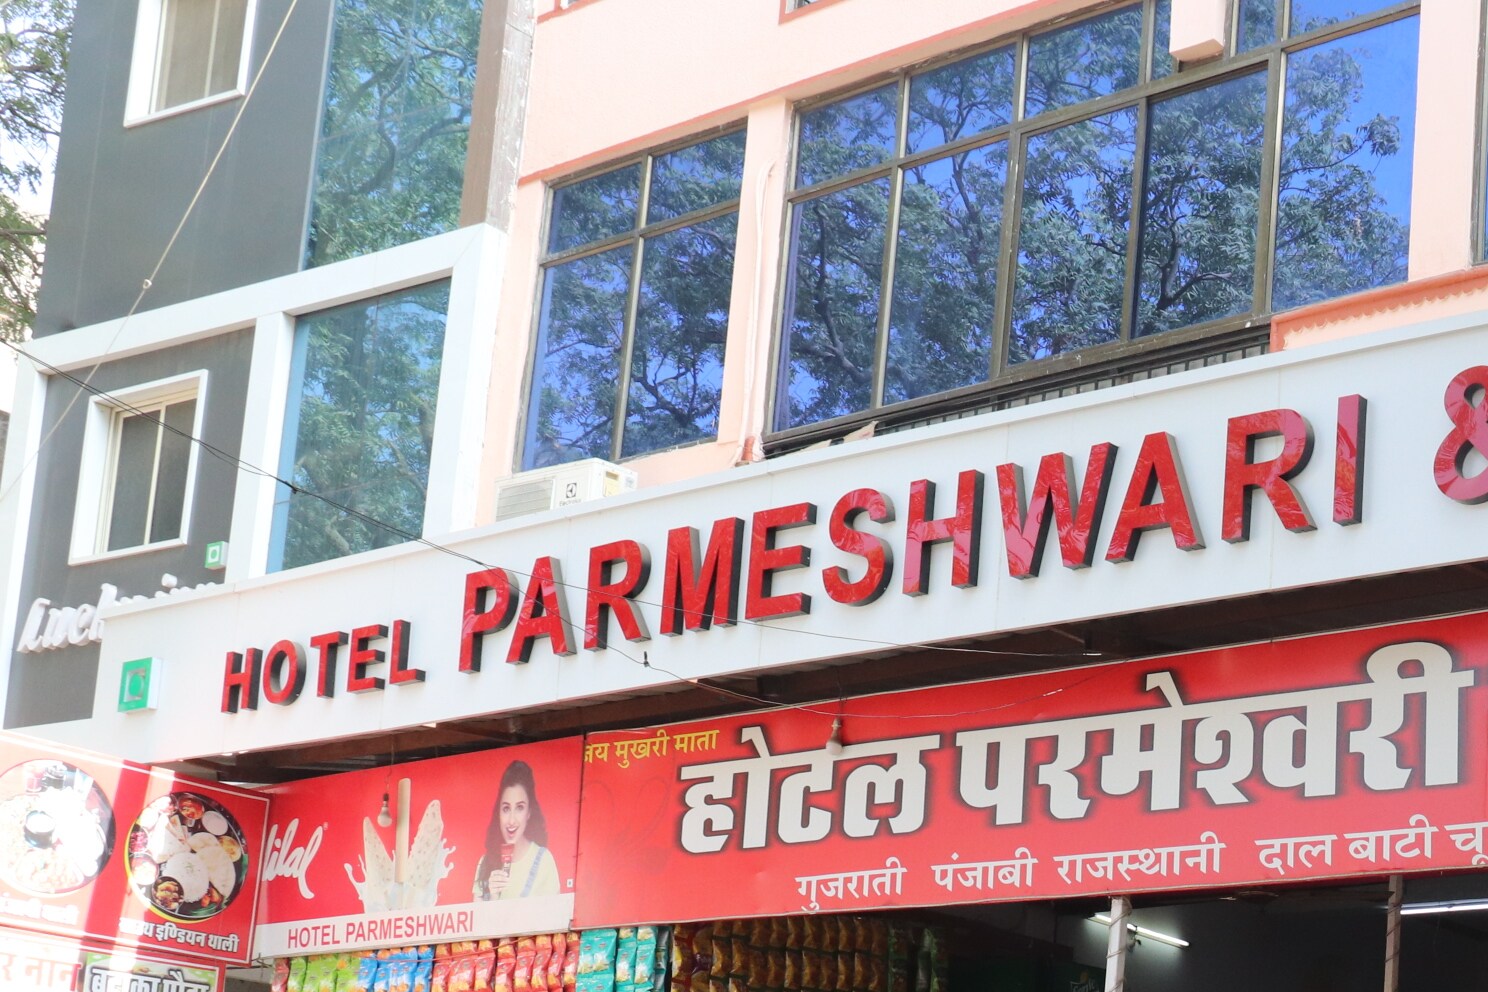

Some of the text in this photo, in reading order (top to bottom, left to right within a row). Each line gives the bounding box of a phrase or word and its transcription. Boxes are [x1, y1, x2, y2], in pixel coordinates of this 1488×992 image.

[221, 619, 426, 713] HOTEL
[457, 394, 1368, 675] PARMESHWARI
[614, 729, 670, 769] मुखरी
[673, 729, 720, 754] माता
[681, 725, 942, 854] होटल
[957, 641, 1478, 826] परमेश्वरी
[795, 856, 908, 913] गुजराती
[931, 846, 1037, 891] पंजाबी
[1055, 831, 1226, 884] राजस्थानी
[1254, 833, 1338, 875] दाल
[1345, 813, 1440, 862] बाटी
[287, 910, 474, 949] HOTEL PARMESHWARI
